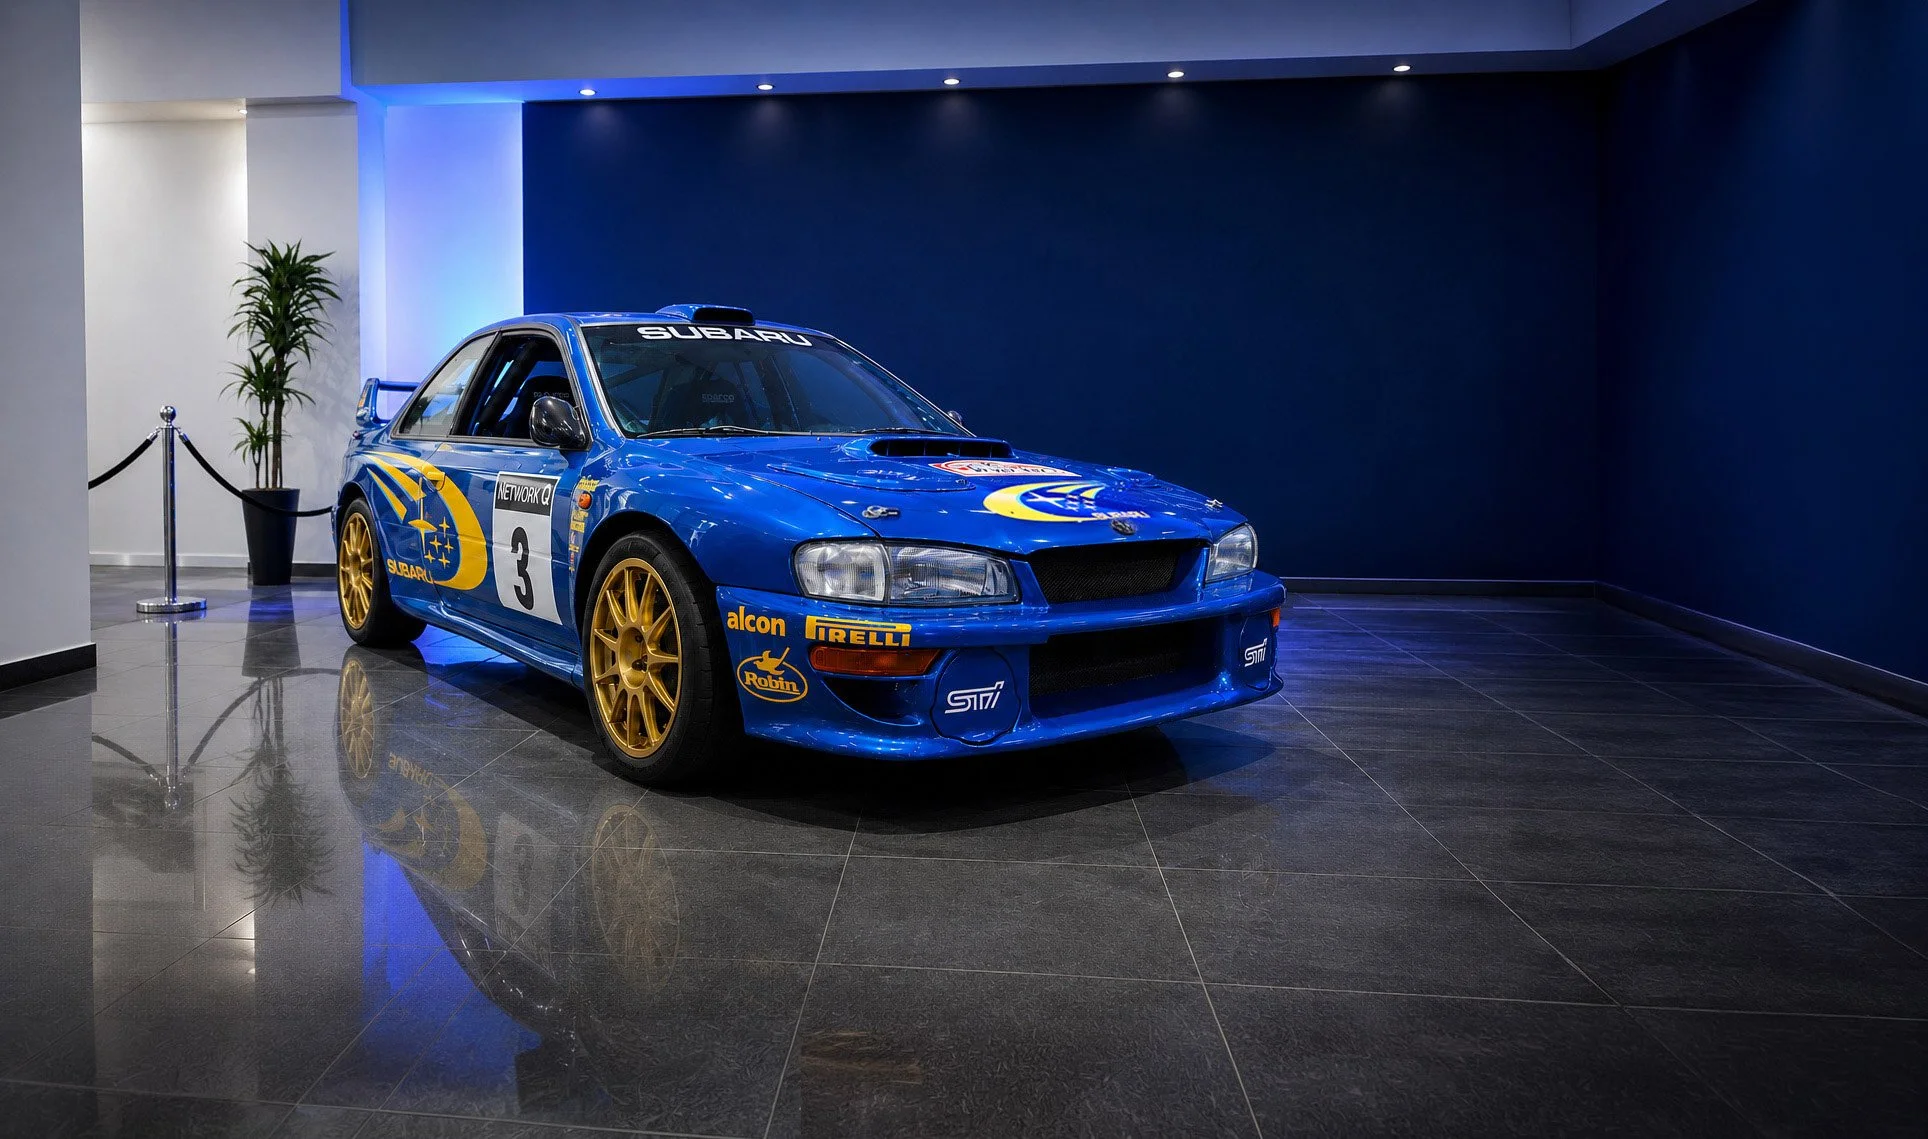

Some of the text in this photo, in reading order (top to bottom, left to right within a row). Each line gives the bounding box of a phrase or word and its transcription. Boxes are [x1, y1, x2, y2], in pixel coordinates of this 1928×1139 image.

[637, 326, 812, 346] SUBARU
[497, 482, 541, 504] NETWORK
[541, 483, 553, 506] Q
[387, 558, 434, 584] SUBARU
[511, 527, 534, 610] 3
[727, 606, 786, 637] alcon
[805, 615, 912, 647] PIRELLI
[744, 671, 800, 694] Robin
